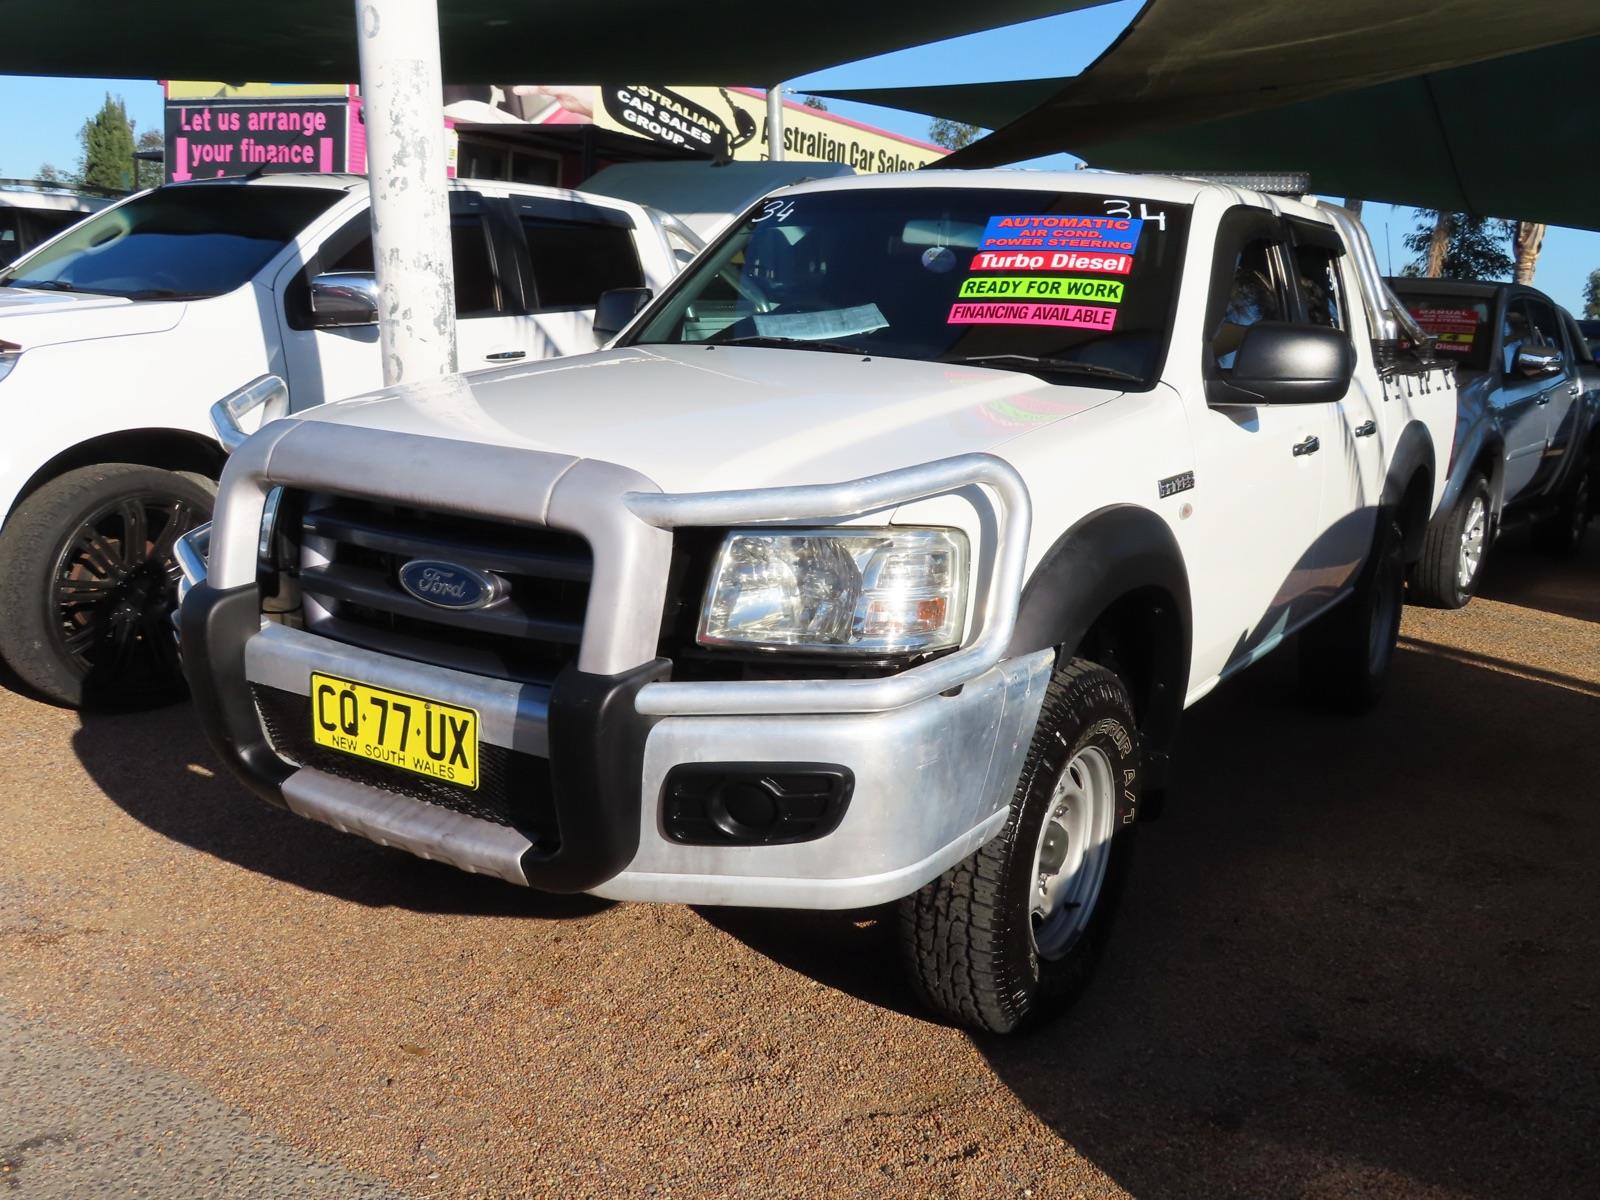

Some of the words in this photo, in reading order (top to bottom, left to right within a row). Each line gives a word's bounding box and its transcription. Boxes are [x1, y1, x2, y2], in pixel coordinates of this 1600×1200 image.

[180, 107, 211, 132] Let
[218, 113, 240, 131] us
[248, 110, 326, 136] arrange
[617, 90, 655, 116] CAR
[659, 111, 711, 144] SALES
[626, 86, 721, 134] STRALIAN
[623, 109, 685, 144] GROUP
[192, 143, 233, 166] your
[240, 138, 315, 164] finance
[850, 141, 875, 173] Car
[752, 200, 794, 223] 34
[998, 217, 1130, 230] AUTOMATIC
[1104, 200, 1165, 231] 34
[985, 238, 1043, 247] POWER
[1048, 239, 1133, 250] STEERING
[1020, 229, 1047, 238] AIR
[1053, 229, 1103, 239] COND.
[980, 254, 1044, 270] Turbo
[1051, 254, 1126, 272] Diesel
[965, 281, 1022, 294] READY
[1026, 281, 1060, 295] FOR
[1067, 283, 1121, 299] WORK
[953, 306, 1029, 319] FINANCING
[1031, 308, 1112, 325] AVAILABLE
[418, 567, 466, 598] Ford
[332, 735, 358, 752] NEW
[365, 744, 406, 766] SOUTH
[413, 757, 455, 780] WALES
